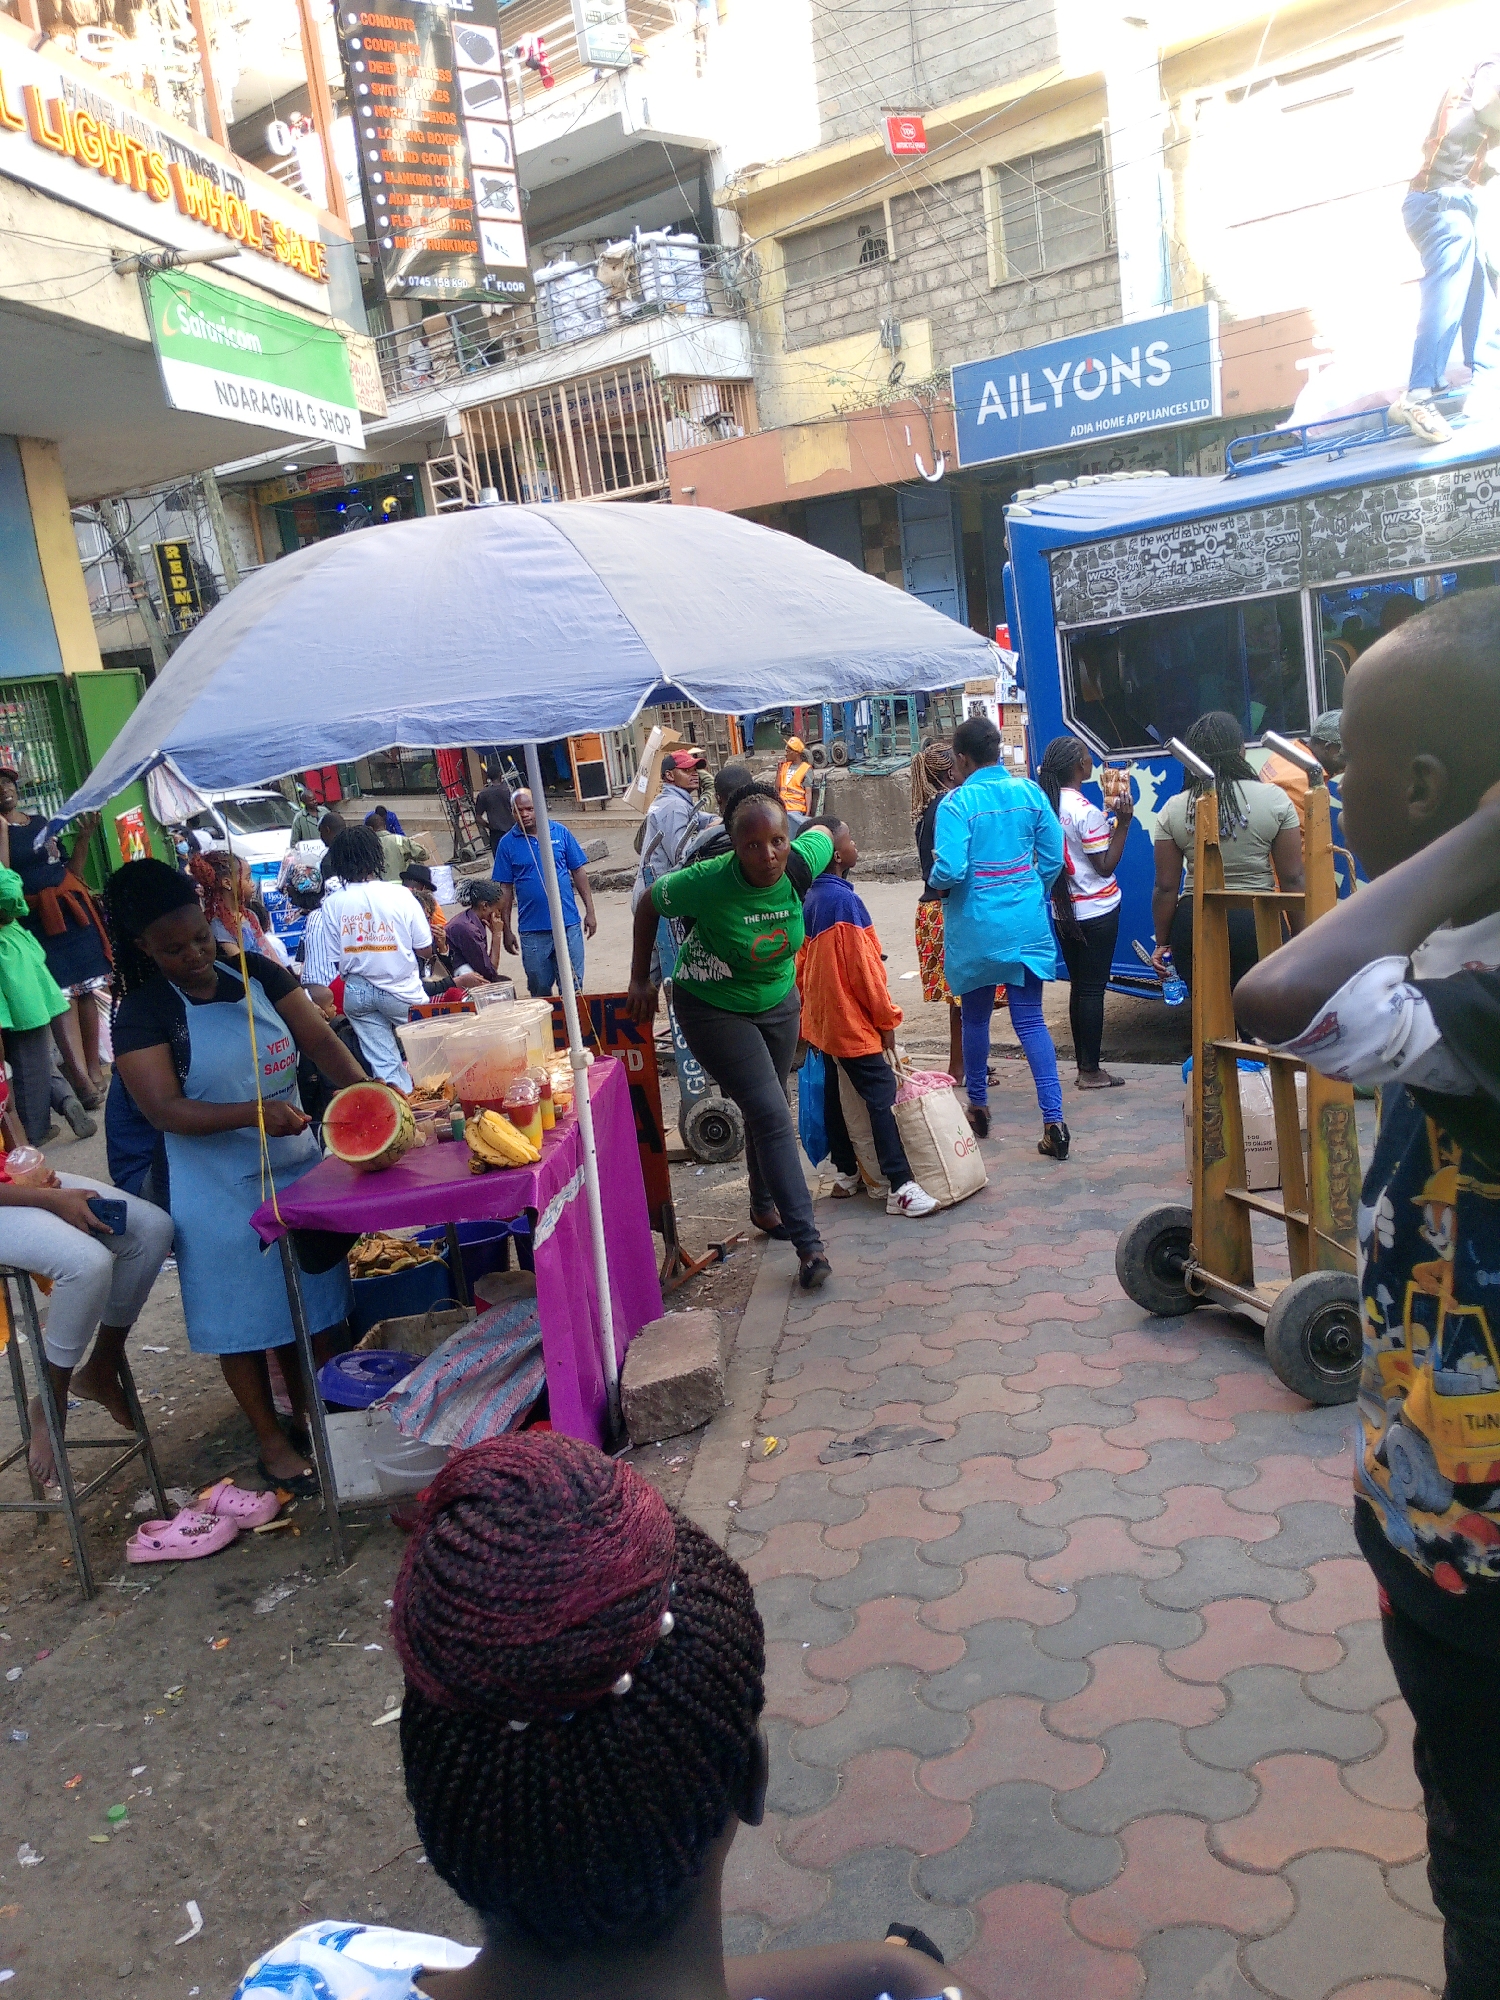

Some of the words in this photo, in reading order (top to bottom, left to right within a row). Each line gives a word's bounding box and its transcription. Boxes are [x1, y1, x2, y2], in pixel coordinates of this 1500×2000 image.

[360, 12, 415, 32] CONDUITS
[363, 37, 420, 56] COUPLERS
[368, 60, 397, 75] DEEP
[370, 82, 411, 99] SWITCH
[414, 87, 450, 103] BOXES
[377, 126, 426, 143] LOOPING
[427, 131, 461, 147] BOXES
[381, 148, 419, 165] ROUND
[421, 152, 462, 168] COVERS
[22, 84, 171, 203] LIGHTS
[168, 162, 331, 285] WHOLESALE
[220, 168, 246, 200] LTD
[384, 170, 432, 186] BLANKING
[434, 174, 471, 189] COVERS
[420, 216, 472, 232] CONDUITS
[408, 275, 431, 287] 0745
[496, 280, 525, 292] FLOOR
[176, 303, 263, 355] Safaricom
[977, 340, 1172, 426] AILYONS
[214, 379, 306, 425] NDARAGWA
[319, 408, 351, 436] SHOP
[1069, 420, 1094, 438] ADIA
[1095, 415, 1125, 433] HOME
[1126, 402, 1189, 426] APPLIANCES
[1190, 398, 1210, 413] LTD
[1453, 469, 1472, 485] the
[1474, 462, 1500, 481] worl
[1383, 508, 1421, 525] WRX
[1140, 534, 1155, 548] the
[1156, 527, 1180, 544] world
[1088, 566, 1117, 582] WRX
[342, 912, 365, 923] Great
[743, 915, 760, 925] THE
[761, 909, 790, 922] MATER
[341, 921, 394, 937] AFRICAN
[266, 1036, 290, 1056] YETU
[264, 1051, 296, 1076] SACCO
